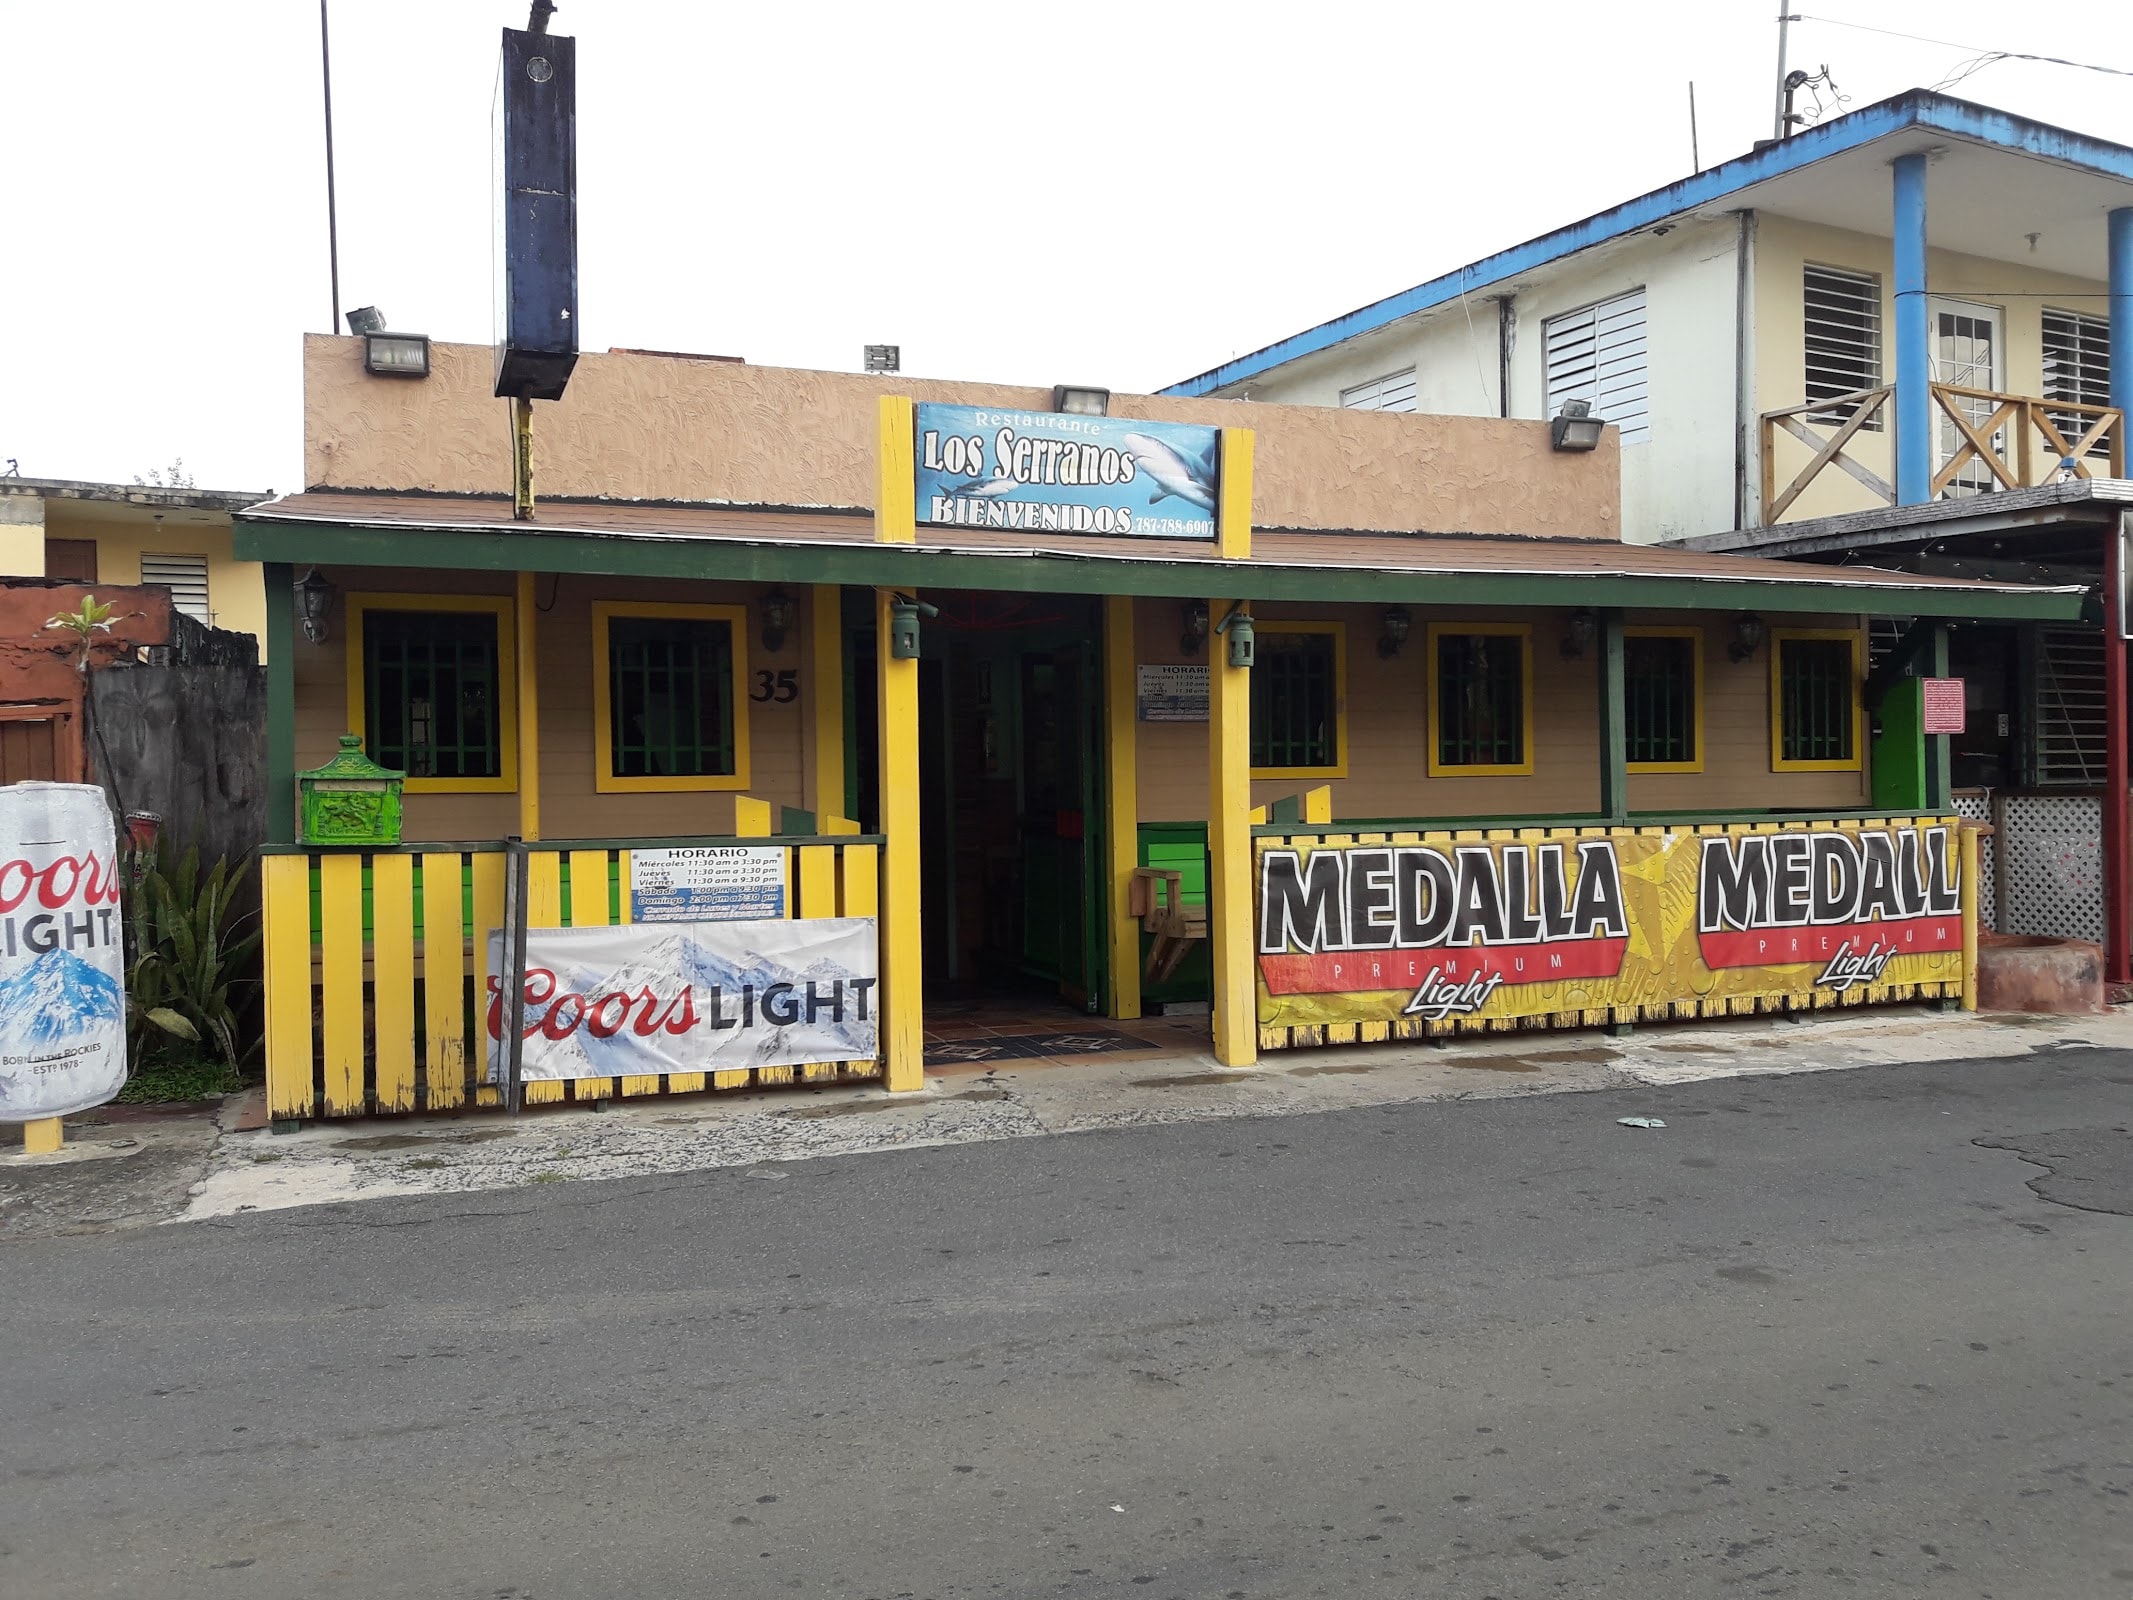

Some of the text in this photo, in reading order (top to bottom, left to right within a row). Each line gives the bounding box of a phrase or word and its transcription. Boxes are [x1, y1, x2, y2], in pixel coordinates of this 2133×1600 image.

[975, 412, 1101, 436] Restaurante
[923, 427, 1136, 486] Los Serranos
[930, 495, 1132, 533] BIENVENIDOS
[749, 669, 798, 703] 35
[1163, 666, 1209, 674] HORARI
[668, 849, 748, 859] HORARIO
[0, 849, 119, 914] oors
[1259, 841, 1630, 954] MEDALLA
[1700, 827, 1962, 933] MEDALL
[639, 897, 685, 905] Domingo
[712, 896, 729, 904] pm
[0, 909, 112, 957] IGHT
[1760, 927, 1946, 953] PREMIUM
[1334, 953, 1562, 979] PREMIUM
[1816, 941, 1897, 991] Light
[487, 968, 876, 1041] Coors LIGHT
[1404, 966, 1503, 1020] Light
[64, 1043, 102, 1057] ROCKIES
